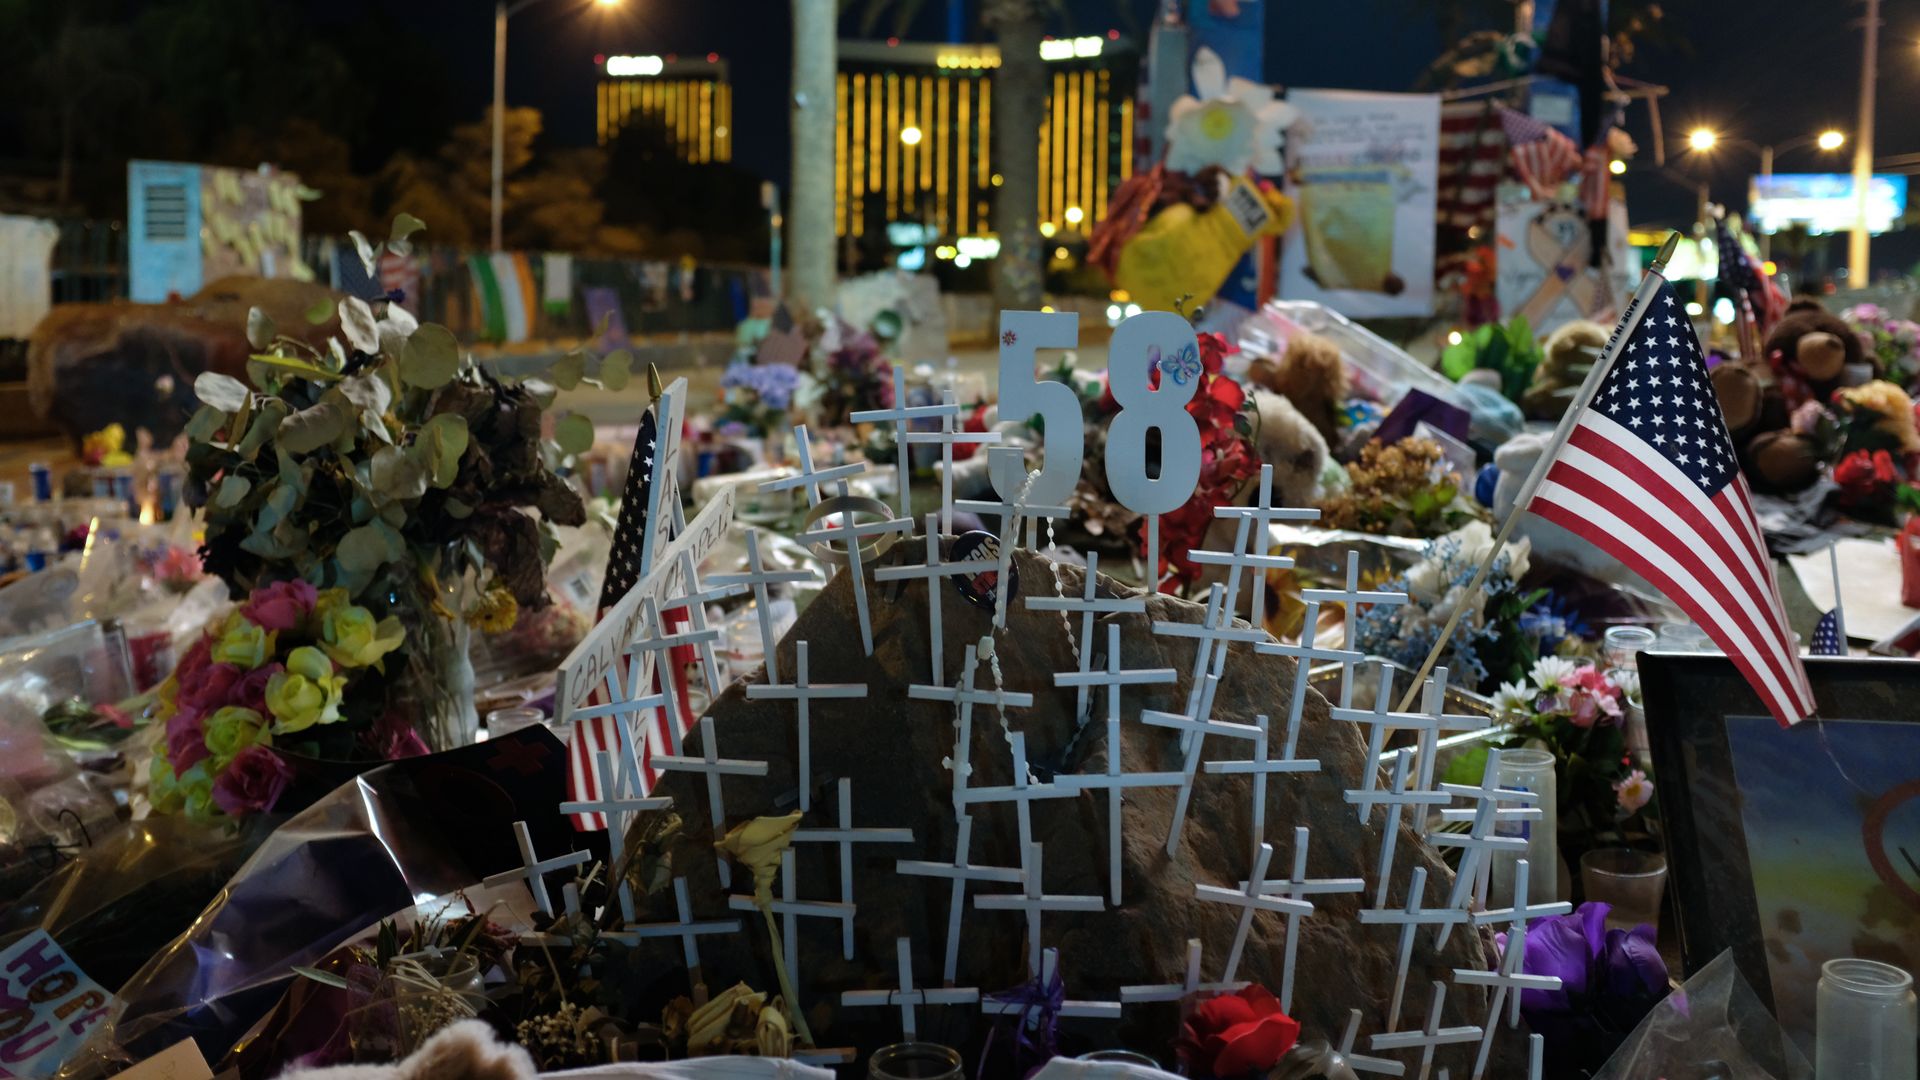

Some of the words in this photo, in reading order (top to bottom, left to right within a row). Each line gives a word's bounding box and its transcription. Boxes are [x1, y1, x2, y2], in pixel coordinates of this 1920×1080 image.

[1615, 324, 1625, 335] IN
[1622, 298, 1640, 323] MADE
[989, 309, 1204, 513] 58
[654, 418, 677, 559] LAS
[572, 580, 659, 705] CALVAR
[6, 937, 110, 1035] HOPE
